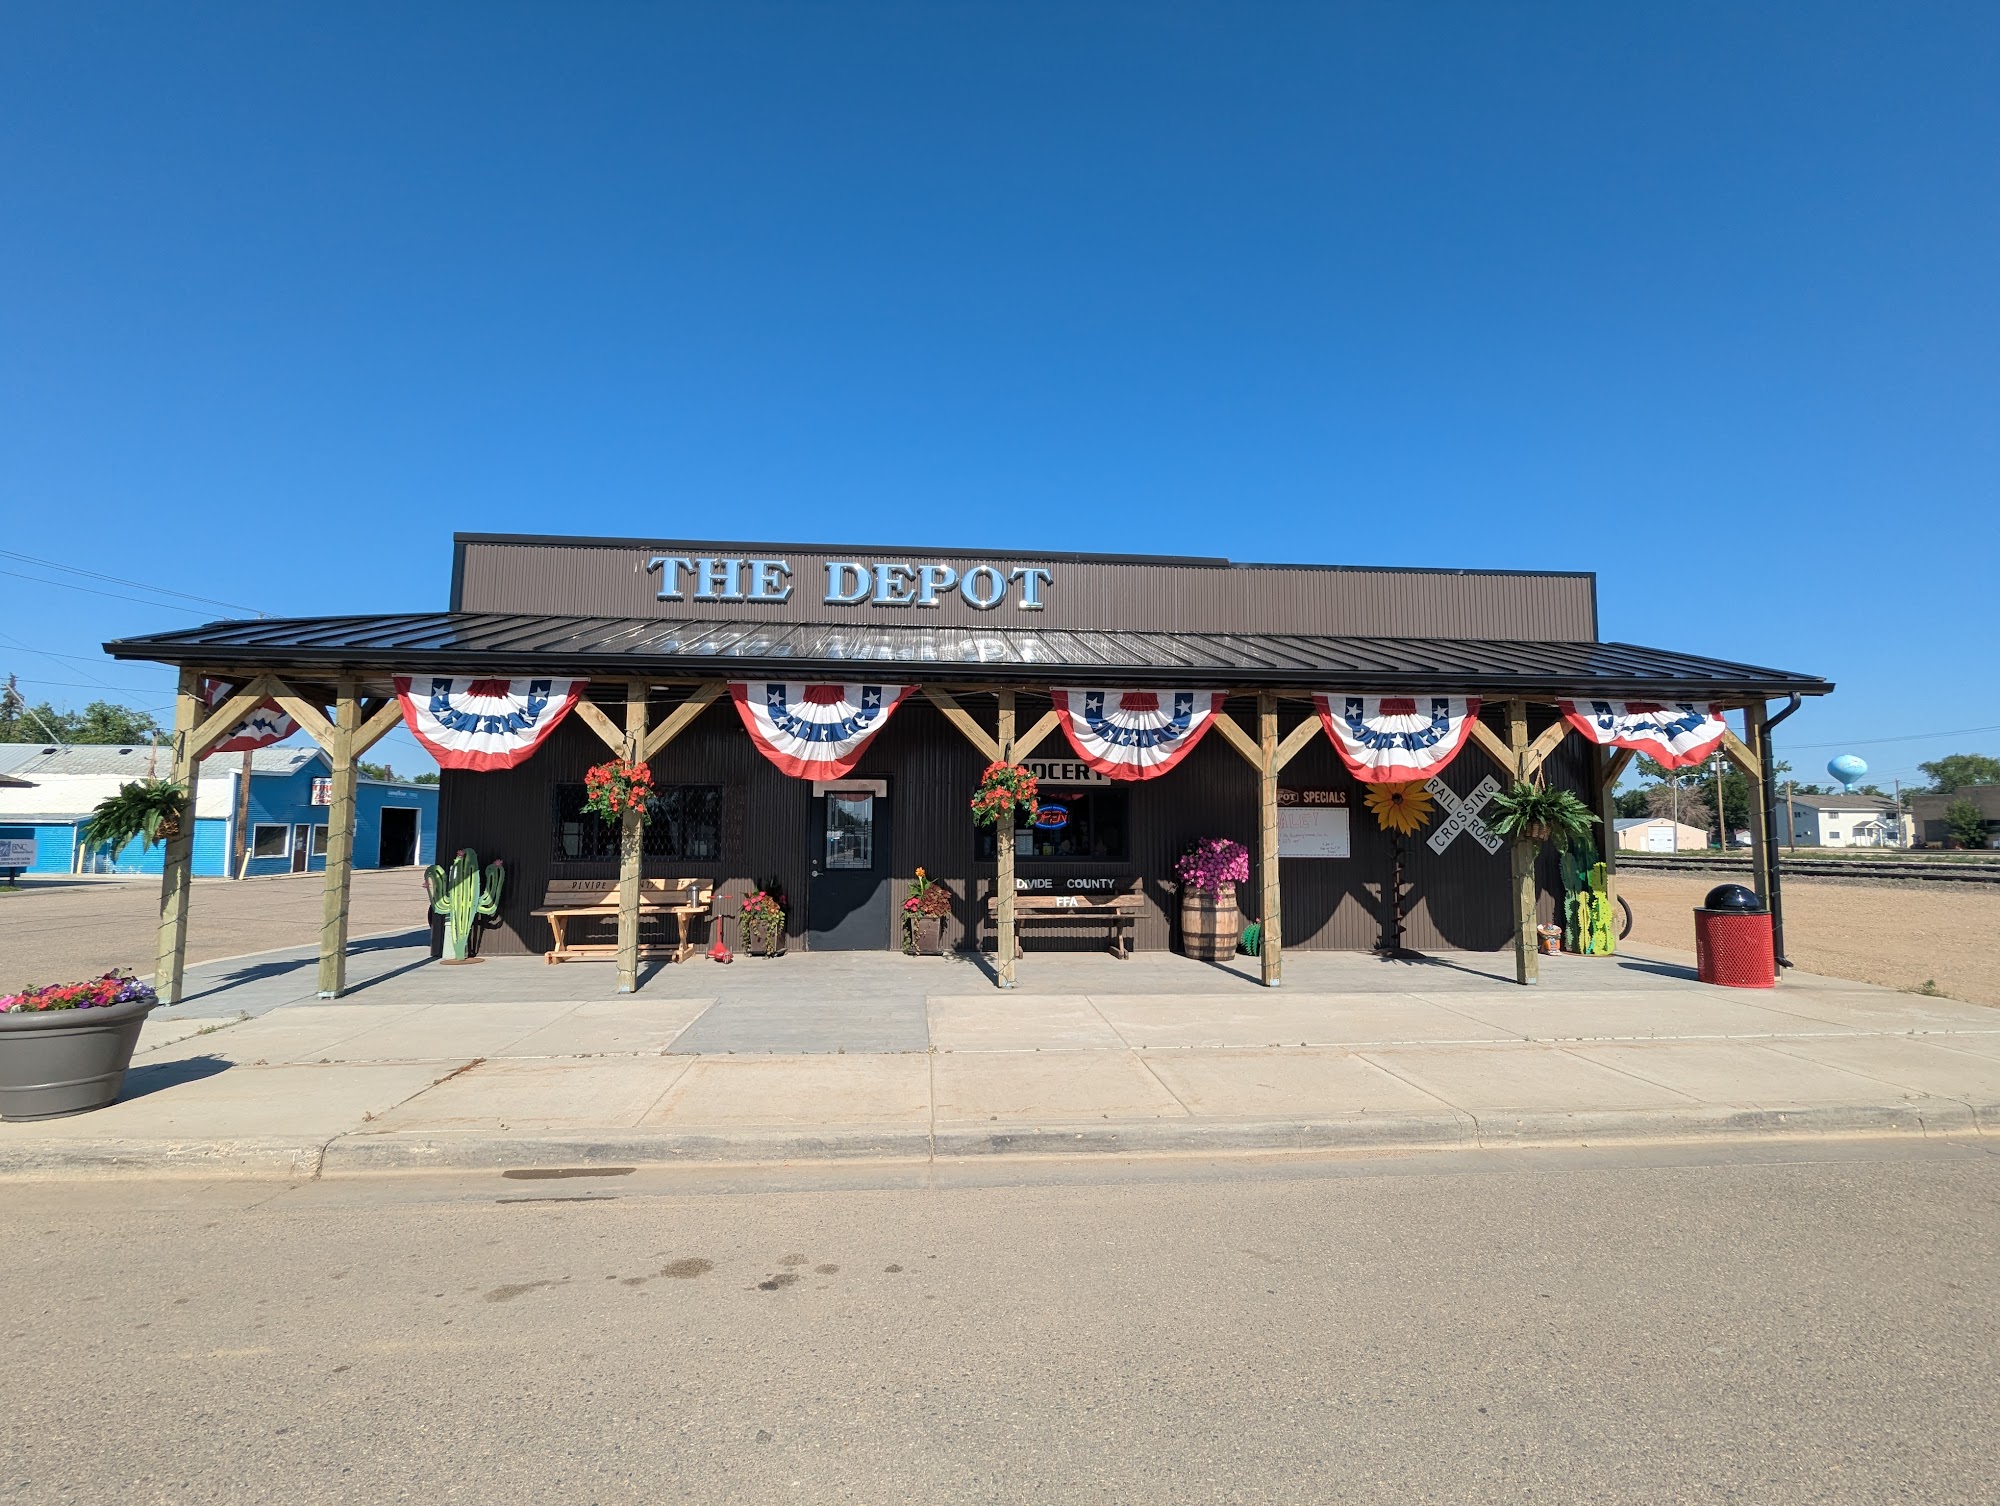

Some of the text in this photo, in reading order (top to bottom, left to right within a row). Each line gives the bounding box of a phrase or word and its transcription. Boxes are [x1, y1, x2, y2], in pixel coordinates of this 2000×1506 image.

[646, 556, 1054, 611] THE DEPOT
[1018, 763, 1103, 780] OCER
[1278, 793, 1296, 801] POT
[1303, 791, 1346, 804] SPECIALS
[1035, 810, 1067, 824] OPEN
[1278, 811, 1319, 829] ALE!
[1427, 779, 1498, 849] RAIL ROAD
[1434, 782, 1494, 847] CROSSING
[12, 843, 27, 851] BNC
[571, 881, 607, 890] DIVIDE
[639, 880, 658, 889] NTY
[1016, 878, 1115, 889] DIVIDE COUNTY
[1056, 896, 1079, 907] FFA
